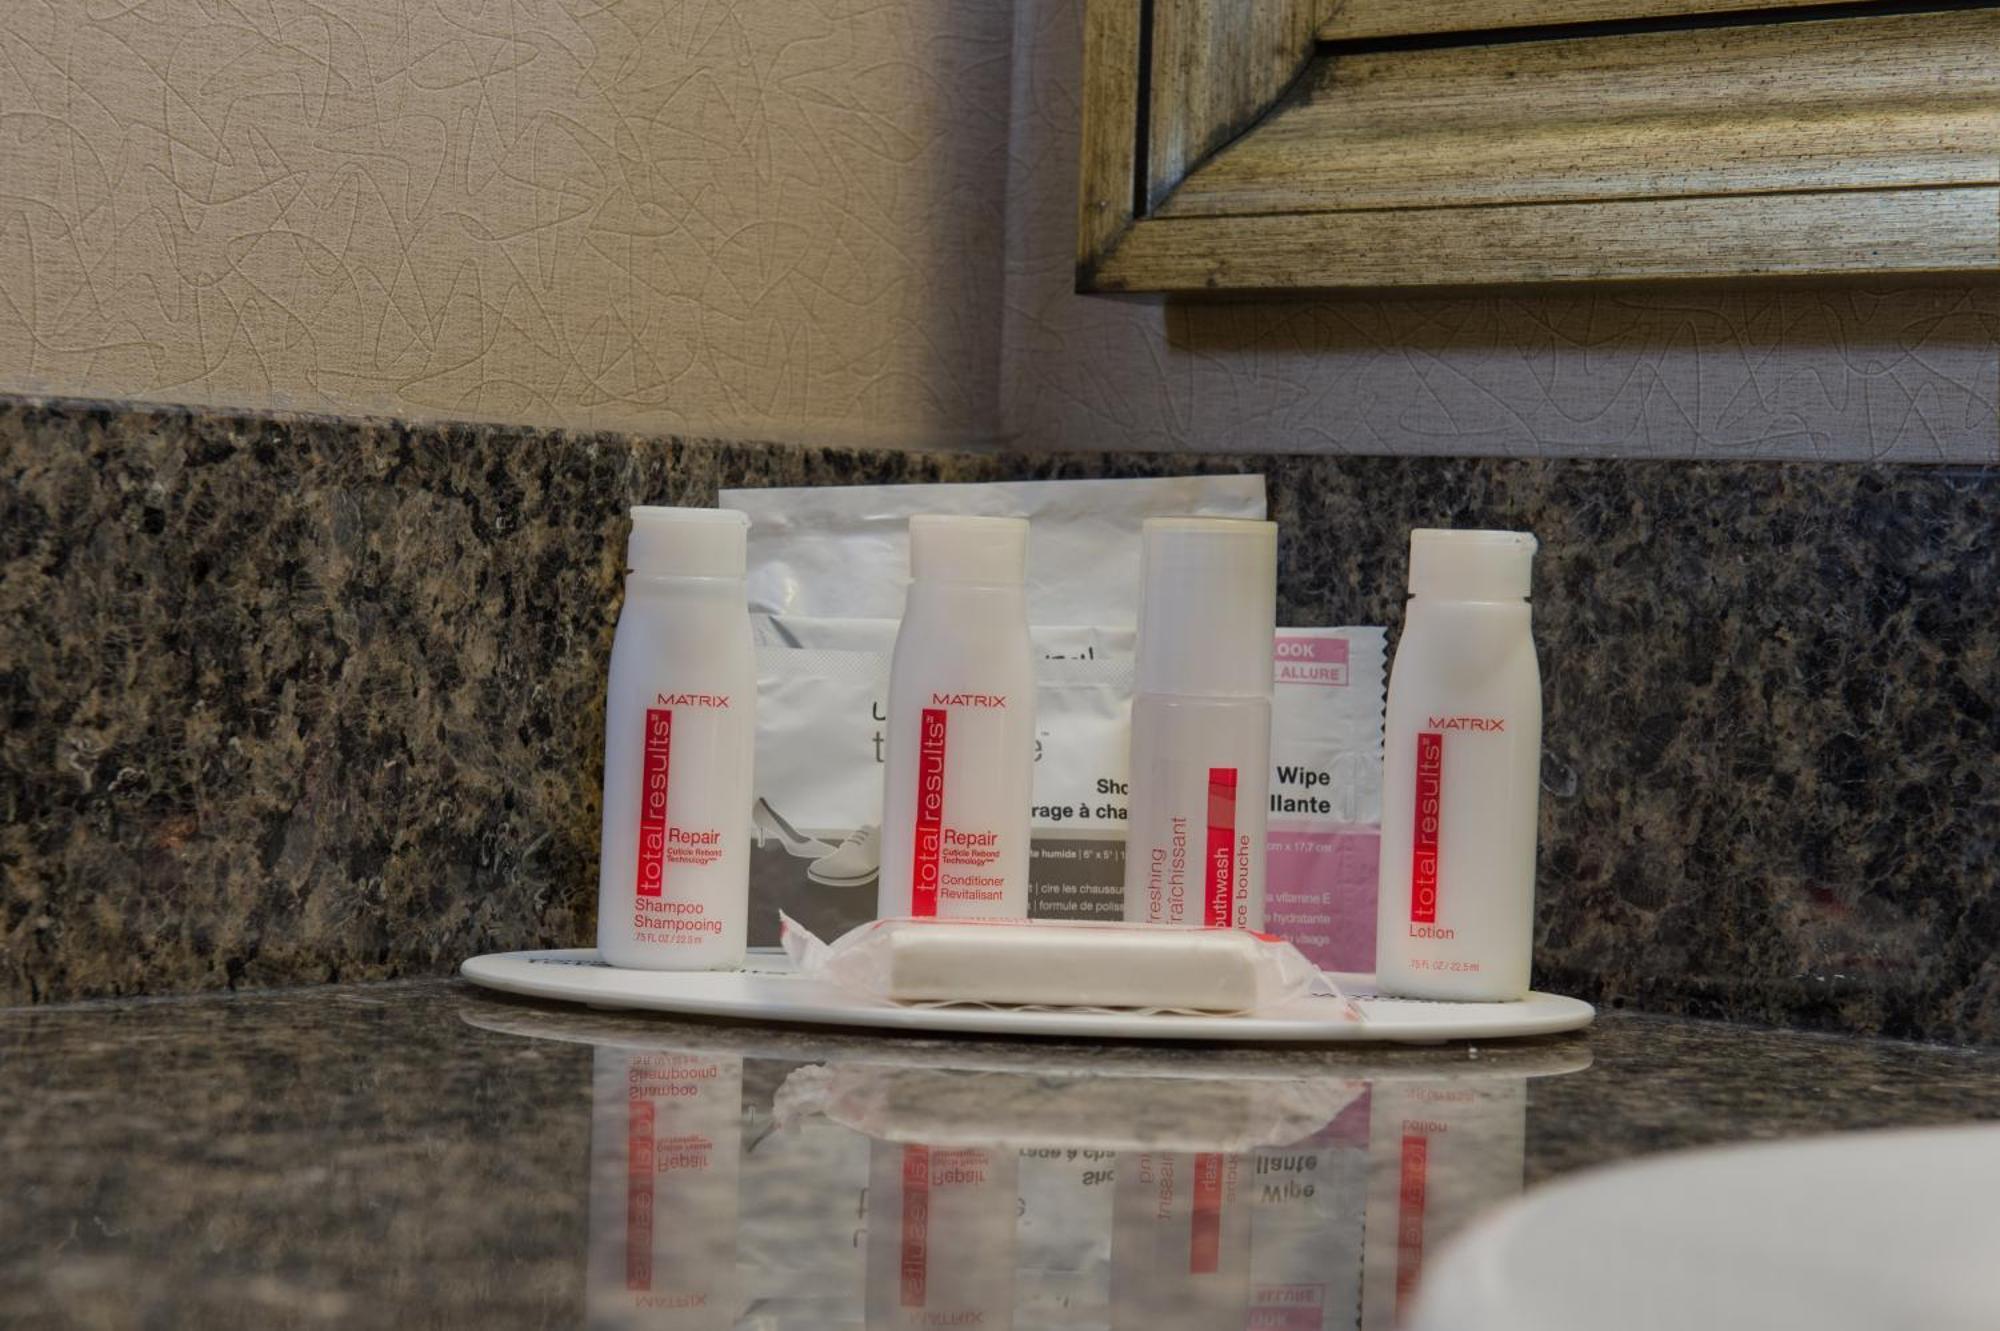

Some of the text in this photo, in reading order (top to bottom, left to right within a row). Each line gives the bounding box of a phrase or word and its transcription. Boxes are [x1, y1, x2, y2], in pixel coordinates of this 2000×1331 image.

[1280, 666, 1340, 681] ALLURE
[657, 693, 729, 708] MATRIX
[932, 693, 1006, 708] MATRIX
[1428, 716, 1505, 731] MATRIX
[1276, 765, 1331, 787] Wipe
[1078, 802, 1091, 819] à
[1270, 793, 1331, 814] llante
[668, 828, 721, 846] Repair
[943, 828, 999, 848] Repair
[1041, 848, 1078, 859] humide
[1236, 834, 1250, 900] bouche
[941, 873, 1005, 888] Conditioner
[939, 888, 1004, 902] Revitalisant
[1040, 882, 1061, 895] cire
[1062, 883, 1078, 895] les
[634, 897, 704, 916] Shampoo
[1039, 901, 1079, 913] formule
[1079, 902, 1094, 913] de
[634, 914, 722, 934] Shampooing
[1408, 924, 1455, 940] Lotion
